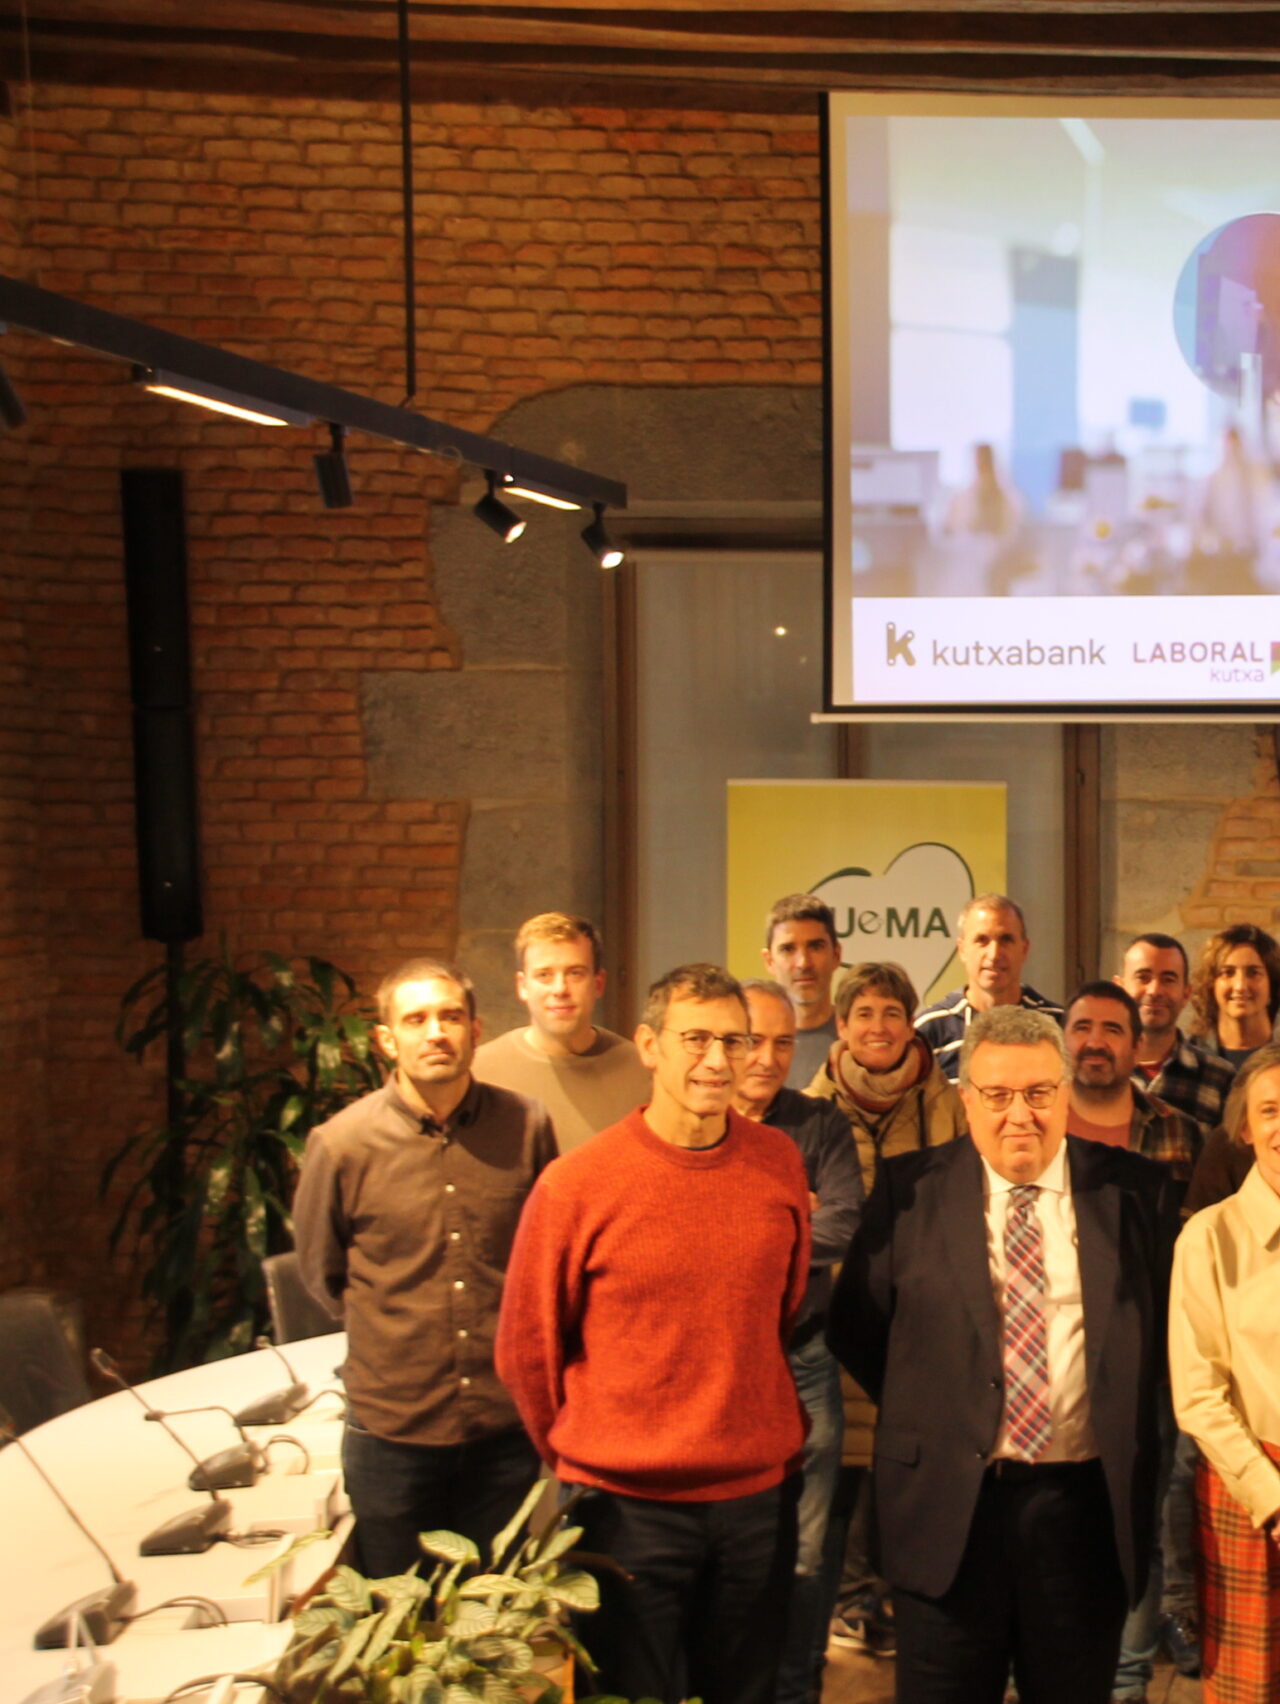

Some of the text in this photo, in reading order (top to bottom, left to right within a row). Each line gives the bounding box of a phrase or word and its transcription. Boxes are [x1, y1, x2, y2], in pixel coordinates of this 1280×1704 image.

[932, 639, 1106, 666] kutxabank
[1133, 642, 1264, 663] LABORAL
[1210, 668, 1265, 683] kutxa
[832, 906, 951, 939] UeMA
